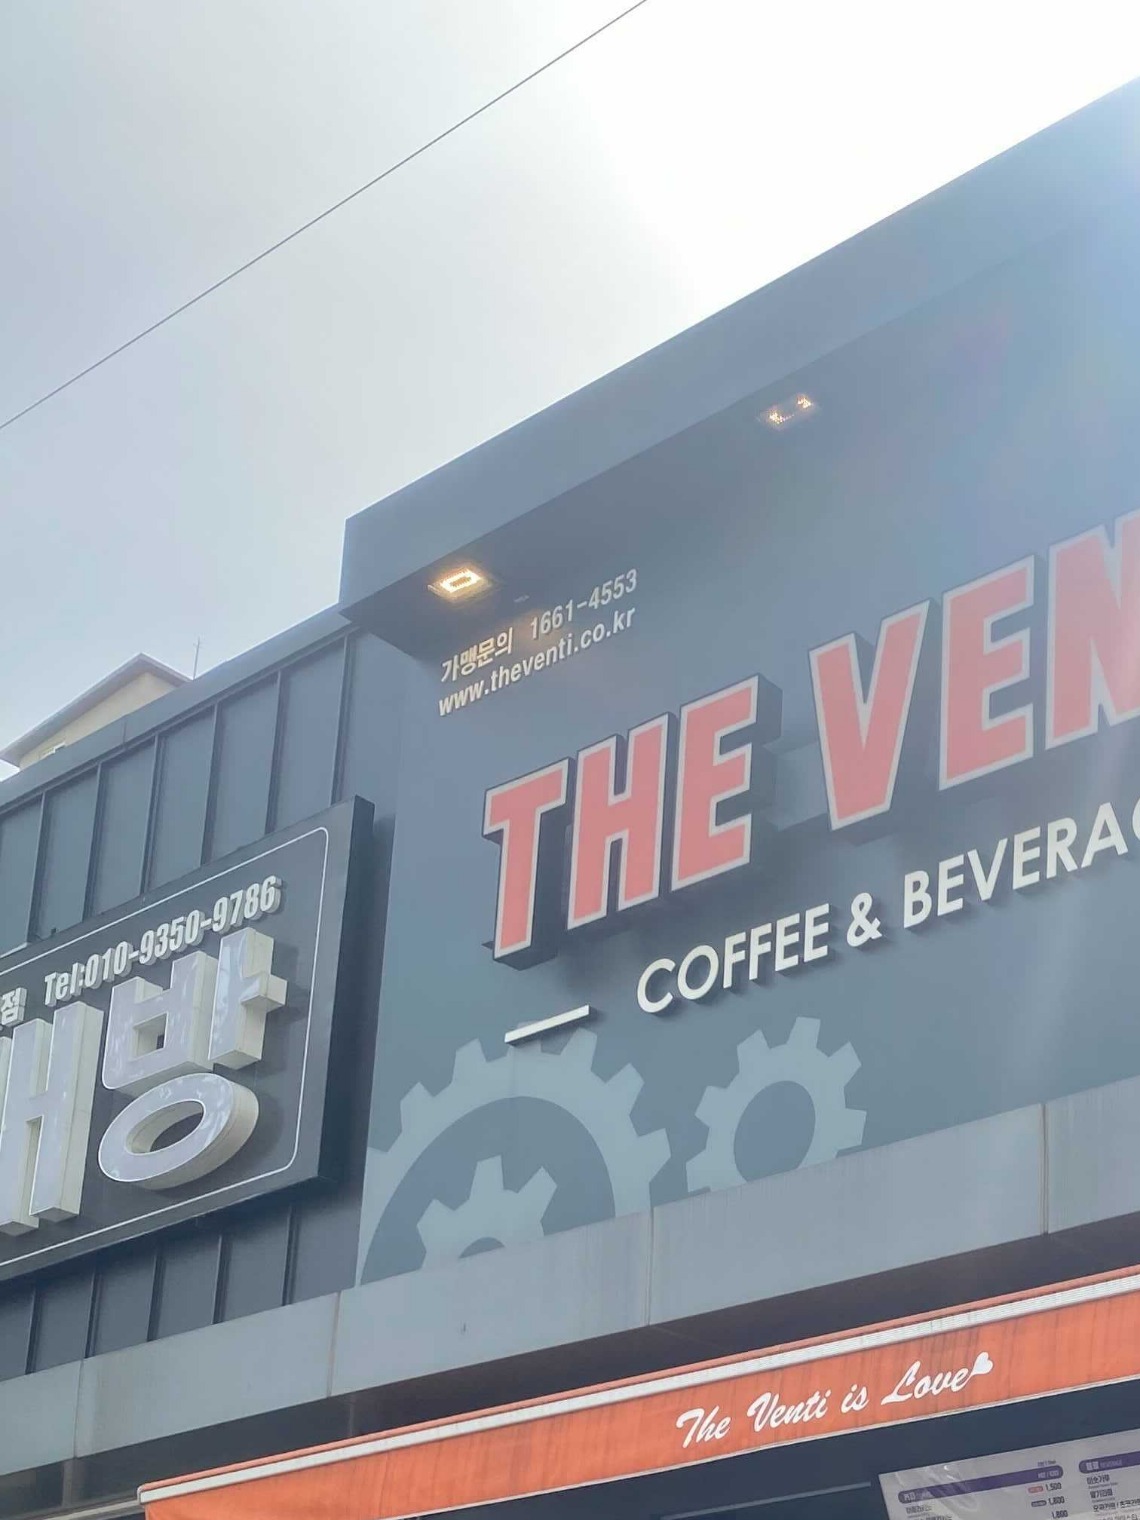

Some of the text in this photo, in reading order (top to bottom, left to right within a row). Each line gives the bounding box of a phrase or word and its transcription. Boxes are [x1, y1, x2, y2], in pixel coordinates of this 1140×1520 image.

[438, 607, 636, 717] www.theventi.co.kr
[440, 569, 638, 684] 가맹문의 1661-4553
[482, 673, 762, 961] THE
[44, 875, 283, 1006] Tel:010-9350-9786
[636, 902, 830, 1014] COFFEE
[845, 892, 882, 947] &
[676, 1359, 973, 1449] The Venti is Love
